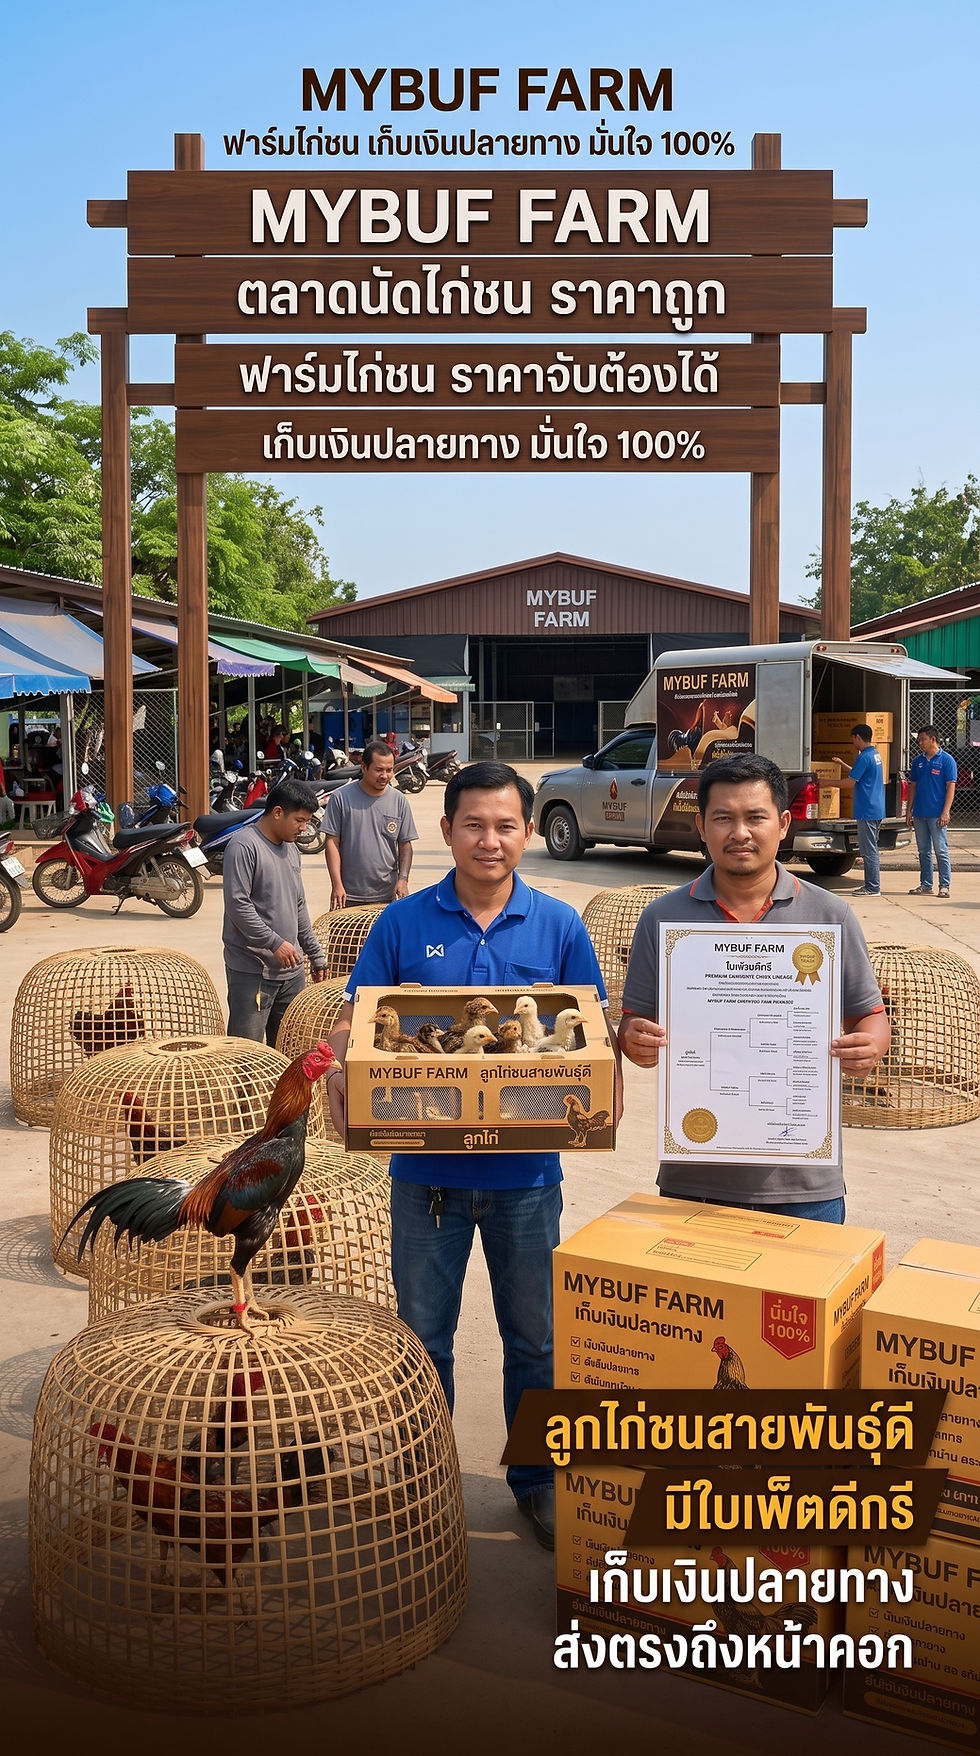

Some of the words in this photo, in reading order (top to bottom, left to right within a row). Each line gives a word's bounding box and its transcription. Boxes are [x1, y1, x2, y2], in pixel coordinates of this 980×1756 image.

[251, 189, 494, 244] MYBUF
[519, 189, 711, 244] FARM
[237, 264, 532, 316] ตลาดนัดไก่ชน
[550, 278, 726, 332] ราคาถูก
[239, 351, 434, 394] ฟาร์มไก่ชน
[452, 351, 718, 394] ราคาจับต้องได้
[262, 421, 520, 461] เก็บเงินปลายทาง
[530, 415, 608, 460] มั่นใจ
[617, 430, 706, 460] 100%
[526, 589, 597, 608] MYBUF
[533, 611, 590, 628] FARM
[663, 674, 708, 691] MYBUF
[711, 672, 749, 689] FARM
[714, 943, 752, 953] MYBUF
[754, 944, 785, 953] FARM
[369, 1067, 422, 1079] MYBUF
[426, 1067, 468, 1079] FARM
[480, 1064, 592, 1083] ลูกไก่ชนสายพันธุ์ดี
[463, 1129, 499, 1149] ลูกไก่
[564, 1270, 648, 1304] MYBUF
[654, 1286, 724, 1320] FARM
[575, 1301, 703, 1344] เก็บเงินปลายทาง
[768, 1323, 810, 1343] 100%
[876, 1330, 976, 1367] MYBUF
[864, 1545, 958, 1583] MYBUF
